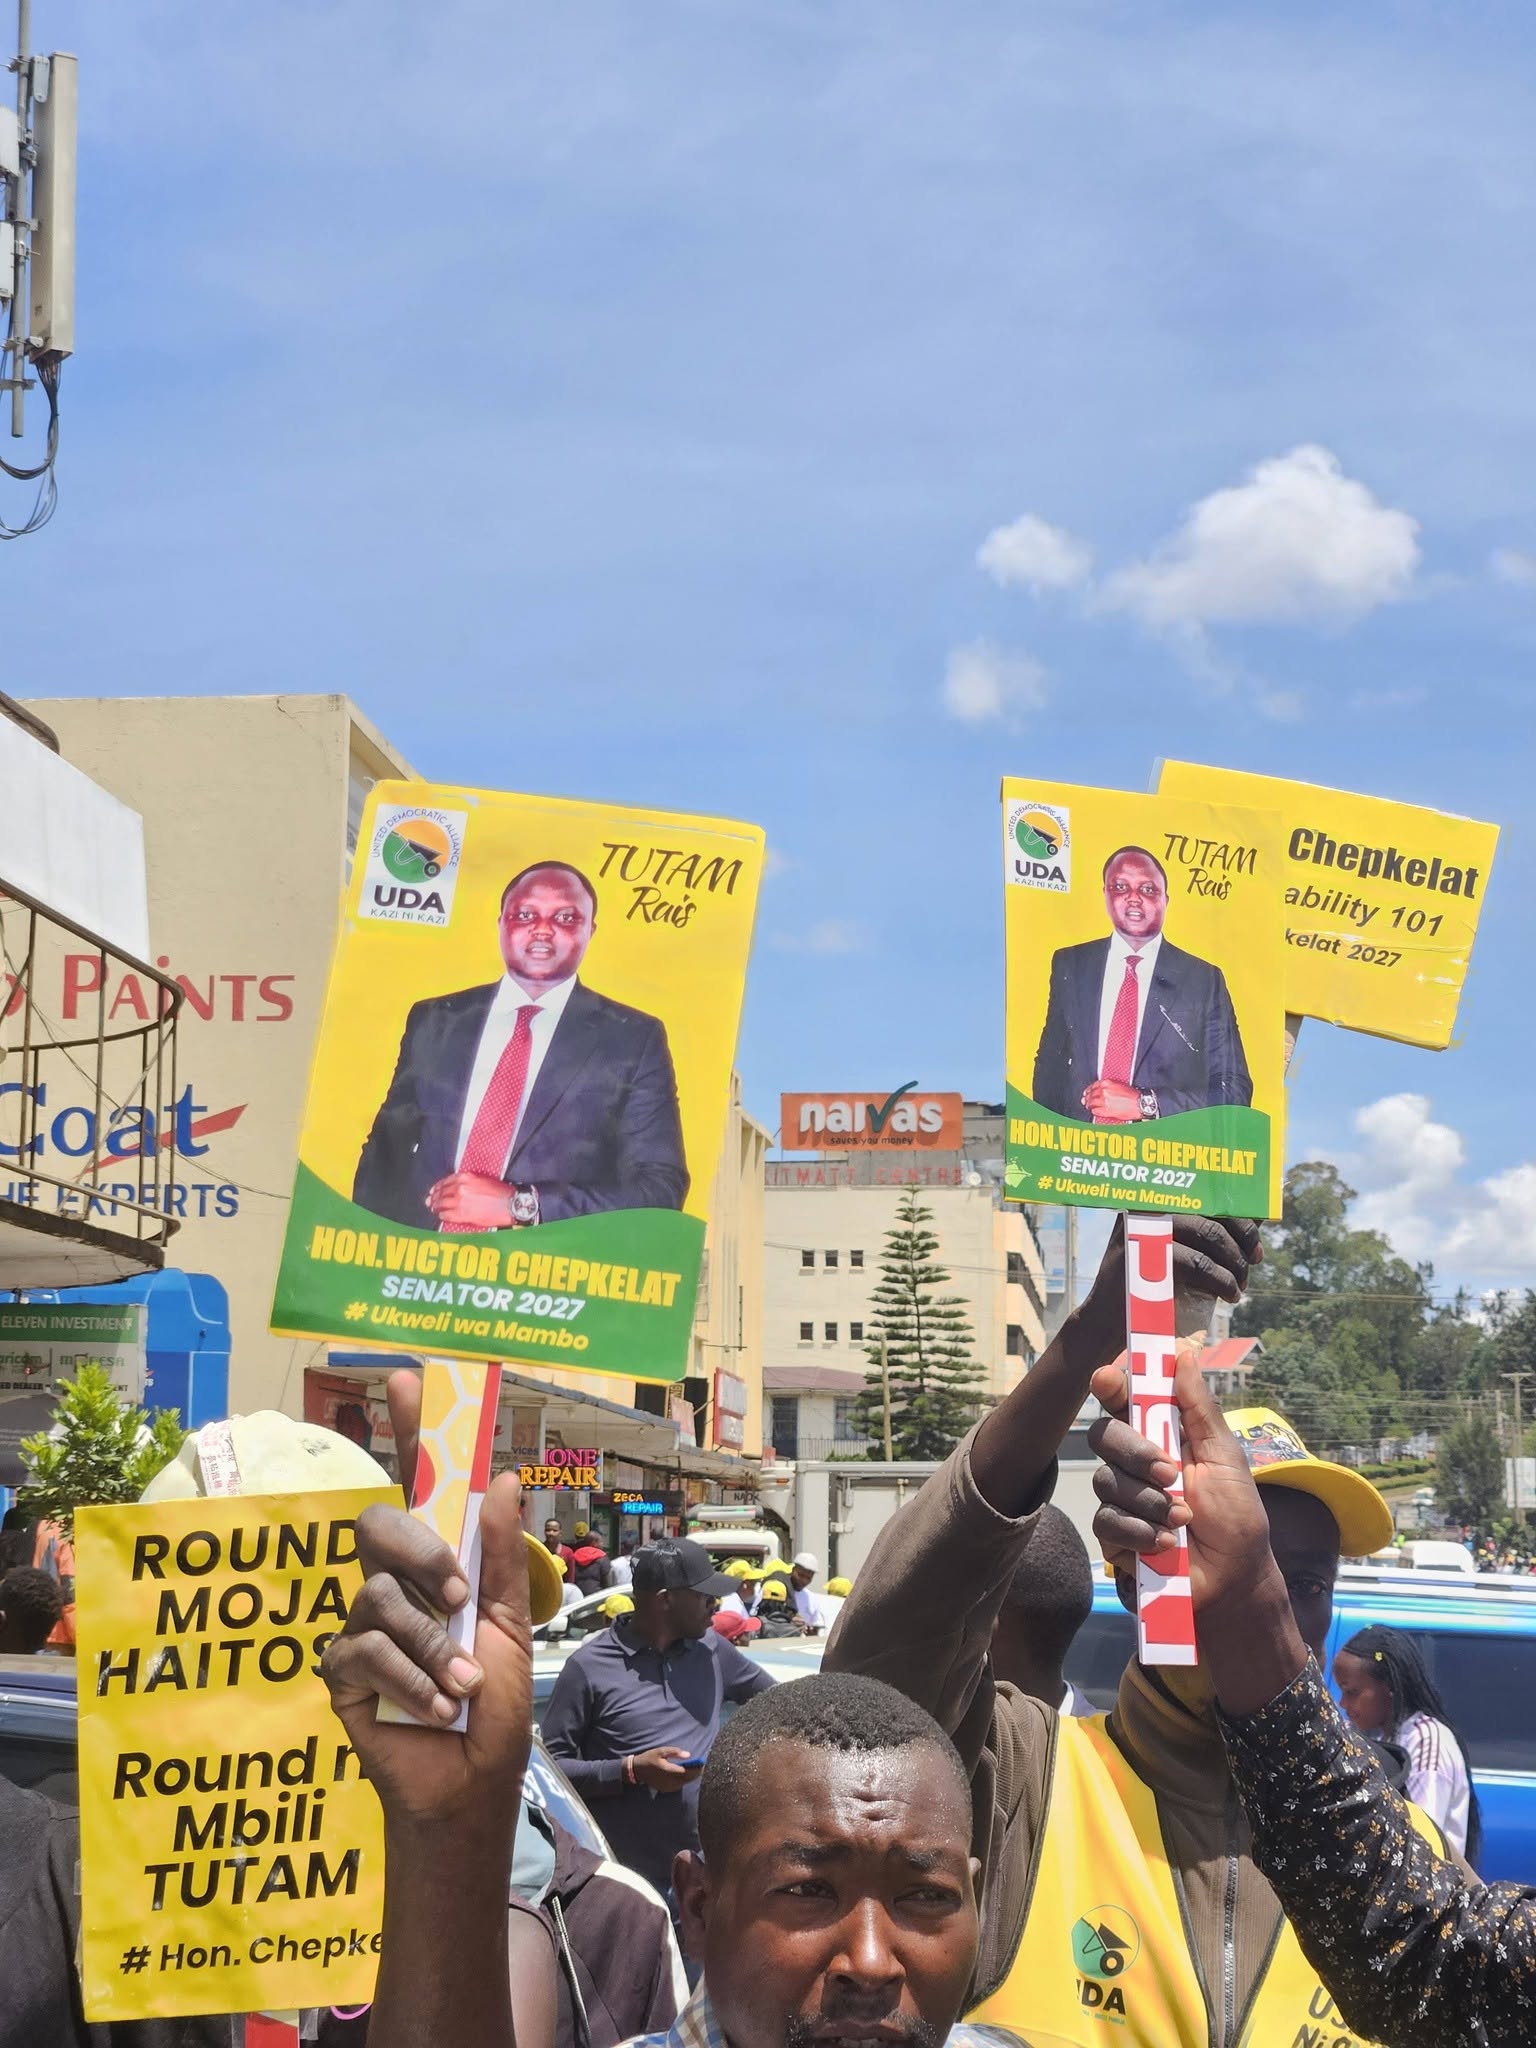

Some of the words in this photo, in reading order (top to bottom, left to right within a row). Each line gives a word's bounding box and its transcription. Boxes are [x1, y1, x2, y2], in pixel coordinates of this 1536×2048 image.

[372, 826, 387, 857] UNITED
[386, 808, 448, 828] DEMOCRATIC
[445, 824, 461, 868] ALLIANCE
[1008, 815, 1017, 839] UNITED
[599, 842, 743, 895] TUTAM
[1015, 860, 1067, 883] UDA
[1164, 833, 1257, 875] TUTAM
[1288, 827, 1479, 899] Chepkelat
[374, 885, 445, 914] UDA
[1015, 877, 1035, 887] KAZI
[1047, 883, 1067, 892] KAZI
[1187, 868, 1232, 900] Rais
[370, 908, 398, 919] KAZI
[402, 911, 414, 920] NI
[417, 913, 446, 925] KAZI
[626, 886, 697, 928] Rais
[1284, 885, 1380, 928] ability
[1391, 906, 1444, 937] 101
[1347, 944, 1402, 968] 2027
[800, 1081, 943, 1133] naivas
[830, 1137, 858, 1145] saves
[861, 1137, 878, 1146] you
[881, 1137, 913, 1146] money
[1010, 1118, 1137, 1161] HON.VICTOR
[1142, 1137, 1257, 1176] CHEPKELAT
[1055, 1178, 1110, 1199] Ukweli
[1112, 1187, 1137, 1201] wa
[1139, 1189, 1202, 1209] Mambo
[1060, 1156, 1149, 1182] SENATOR
[1152, 1168, 1197, 1189] 2027
[310, 1225, 500, 1282] HON.VICTOR
[505, 1250, 682, 1307] CHEPKELAT
[382, 1275, 514, 1312] SENATOR
[515, 1291, 586, 1321] 2027
[1, 1315, 47, 1329] ELEVEN
[50, 1316, 133, 1330] INVESTMENT
[370, 1304, 452, 1332] Ukweli
[453, 1317, 491, 1337] wa
[493, 1320, 589, 1350] Mambo
[520, 1466, 600, 1487] REPAIR
[623, 1502, 664, 1515] REPAIR
[132, 1519, 360, 1581] ROUND
[155, 1576, 348, 1636] MOJA
[113, 1735, 318, 1800] Round
[172, 1787, 326, 1852] Mbili
[144, 1848, 361, 1912] TUTAM
[159, 1942, 241, 1971] Hon.
[1076, 1978, 1126, 2016] DA
